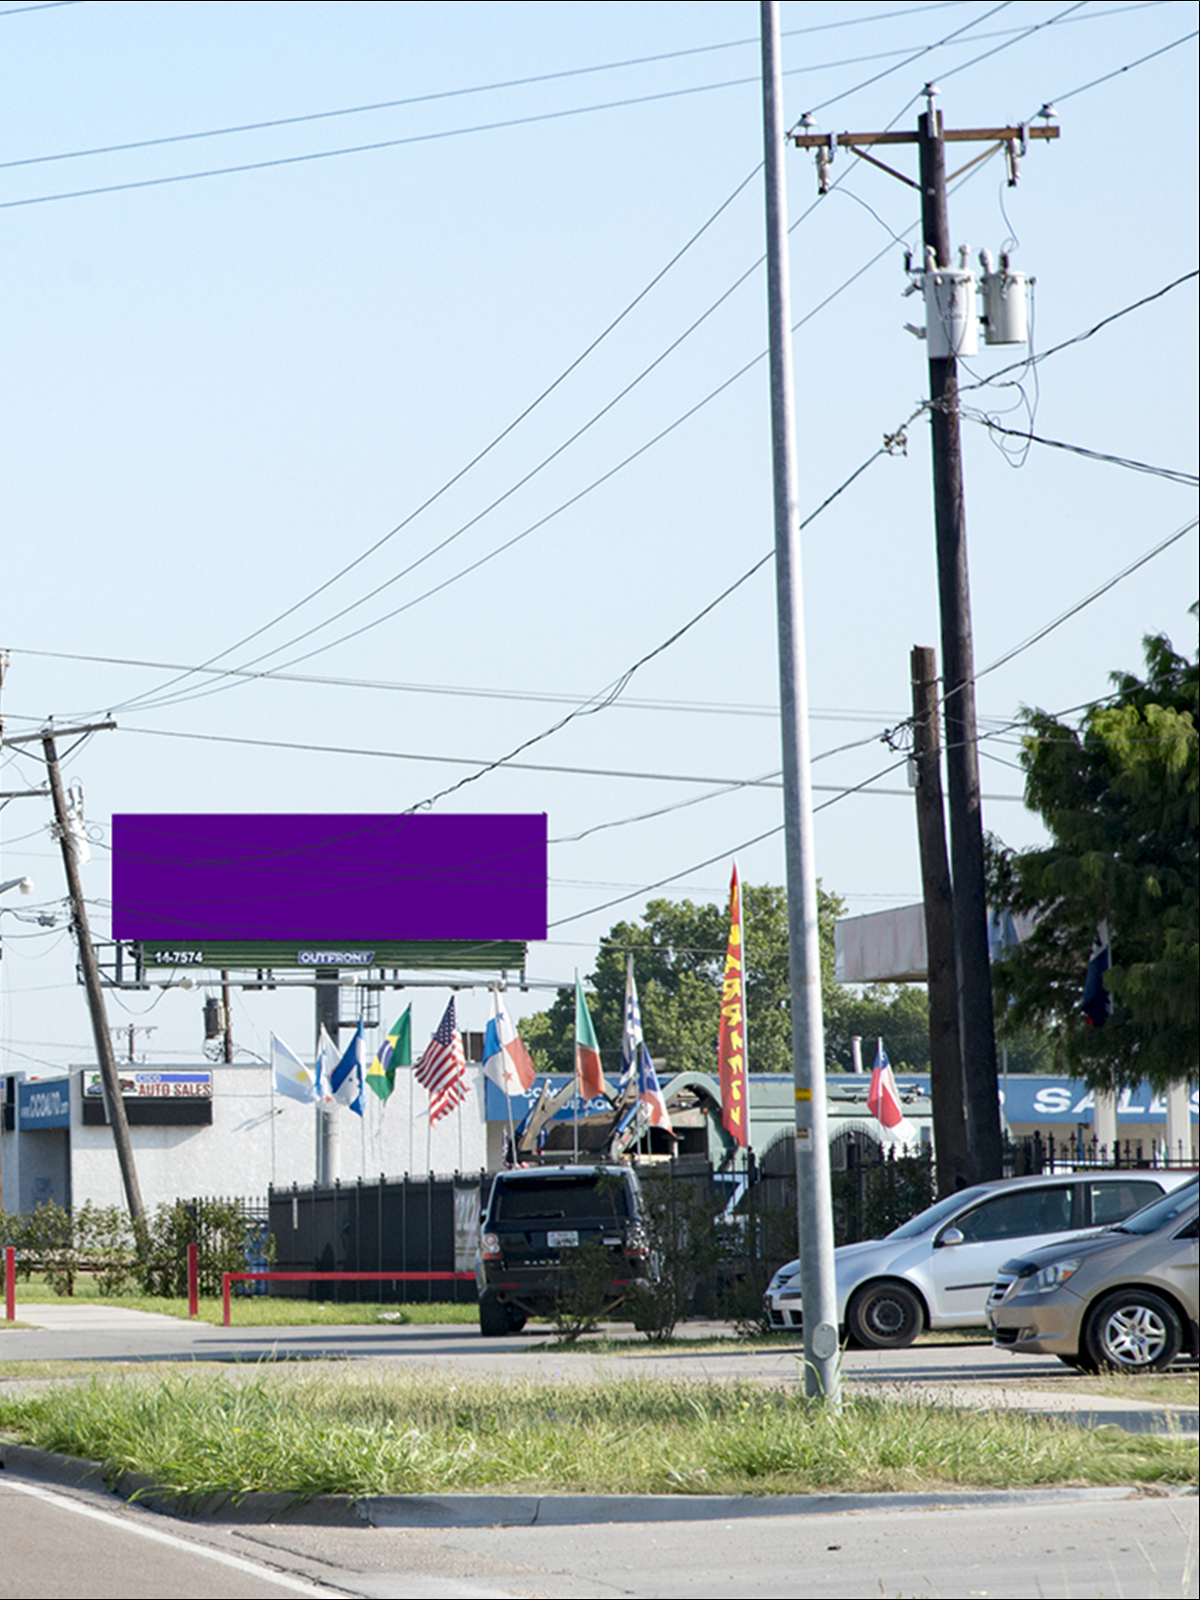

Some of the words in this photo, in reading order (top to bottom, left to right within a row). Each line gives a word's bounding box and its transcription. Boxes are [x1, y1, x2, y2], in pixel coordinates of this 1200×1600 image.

[154, 951, 204, 963] 14-7574
[300, 952, 369, 964] OUTFRONT
[138, 1083, 171, 1096] AUTO
[174, 1083, 211, 1096] SALES
